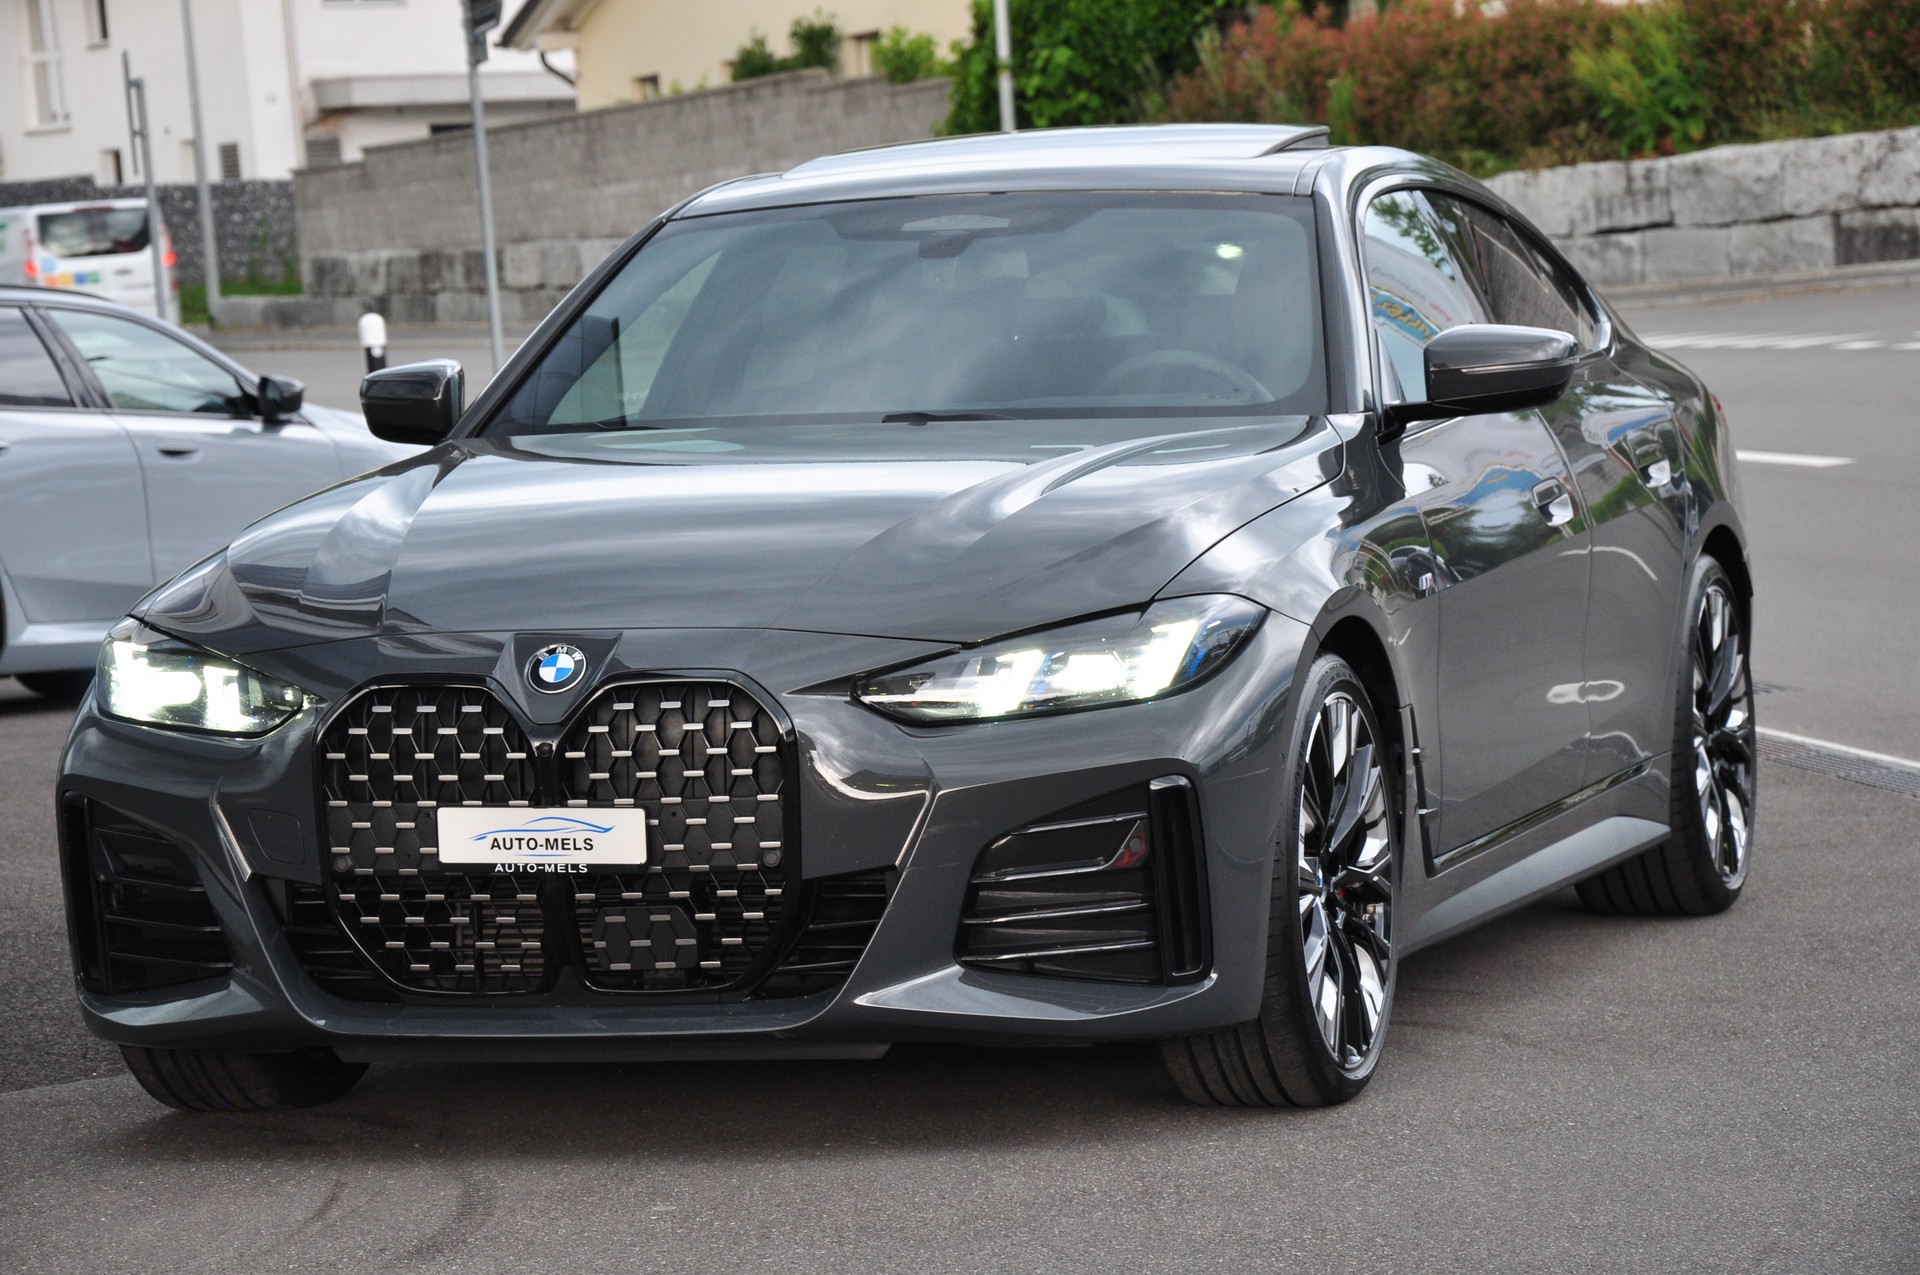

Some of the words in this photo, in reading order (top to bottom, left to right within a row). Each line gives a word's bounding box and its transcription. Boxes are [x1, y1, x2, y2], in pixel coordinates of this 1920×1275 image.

[538, 646, 583, 661] BMW
[490, 837, 594, 851] AUTO-MELS
[494, 863, 588, 873] AUTO-MELS
